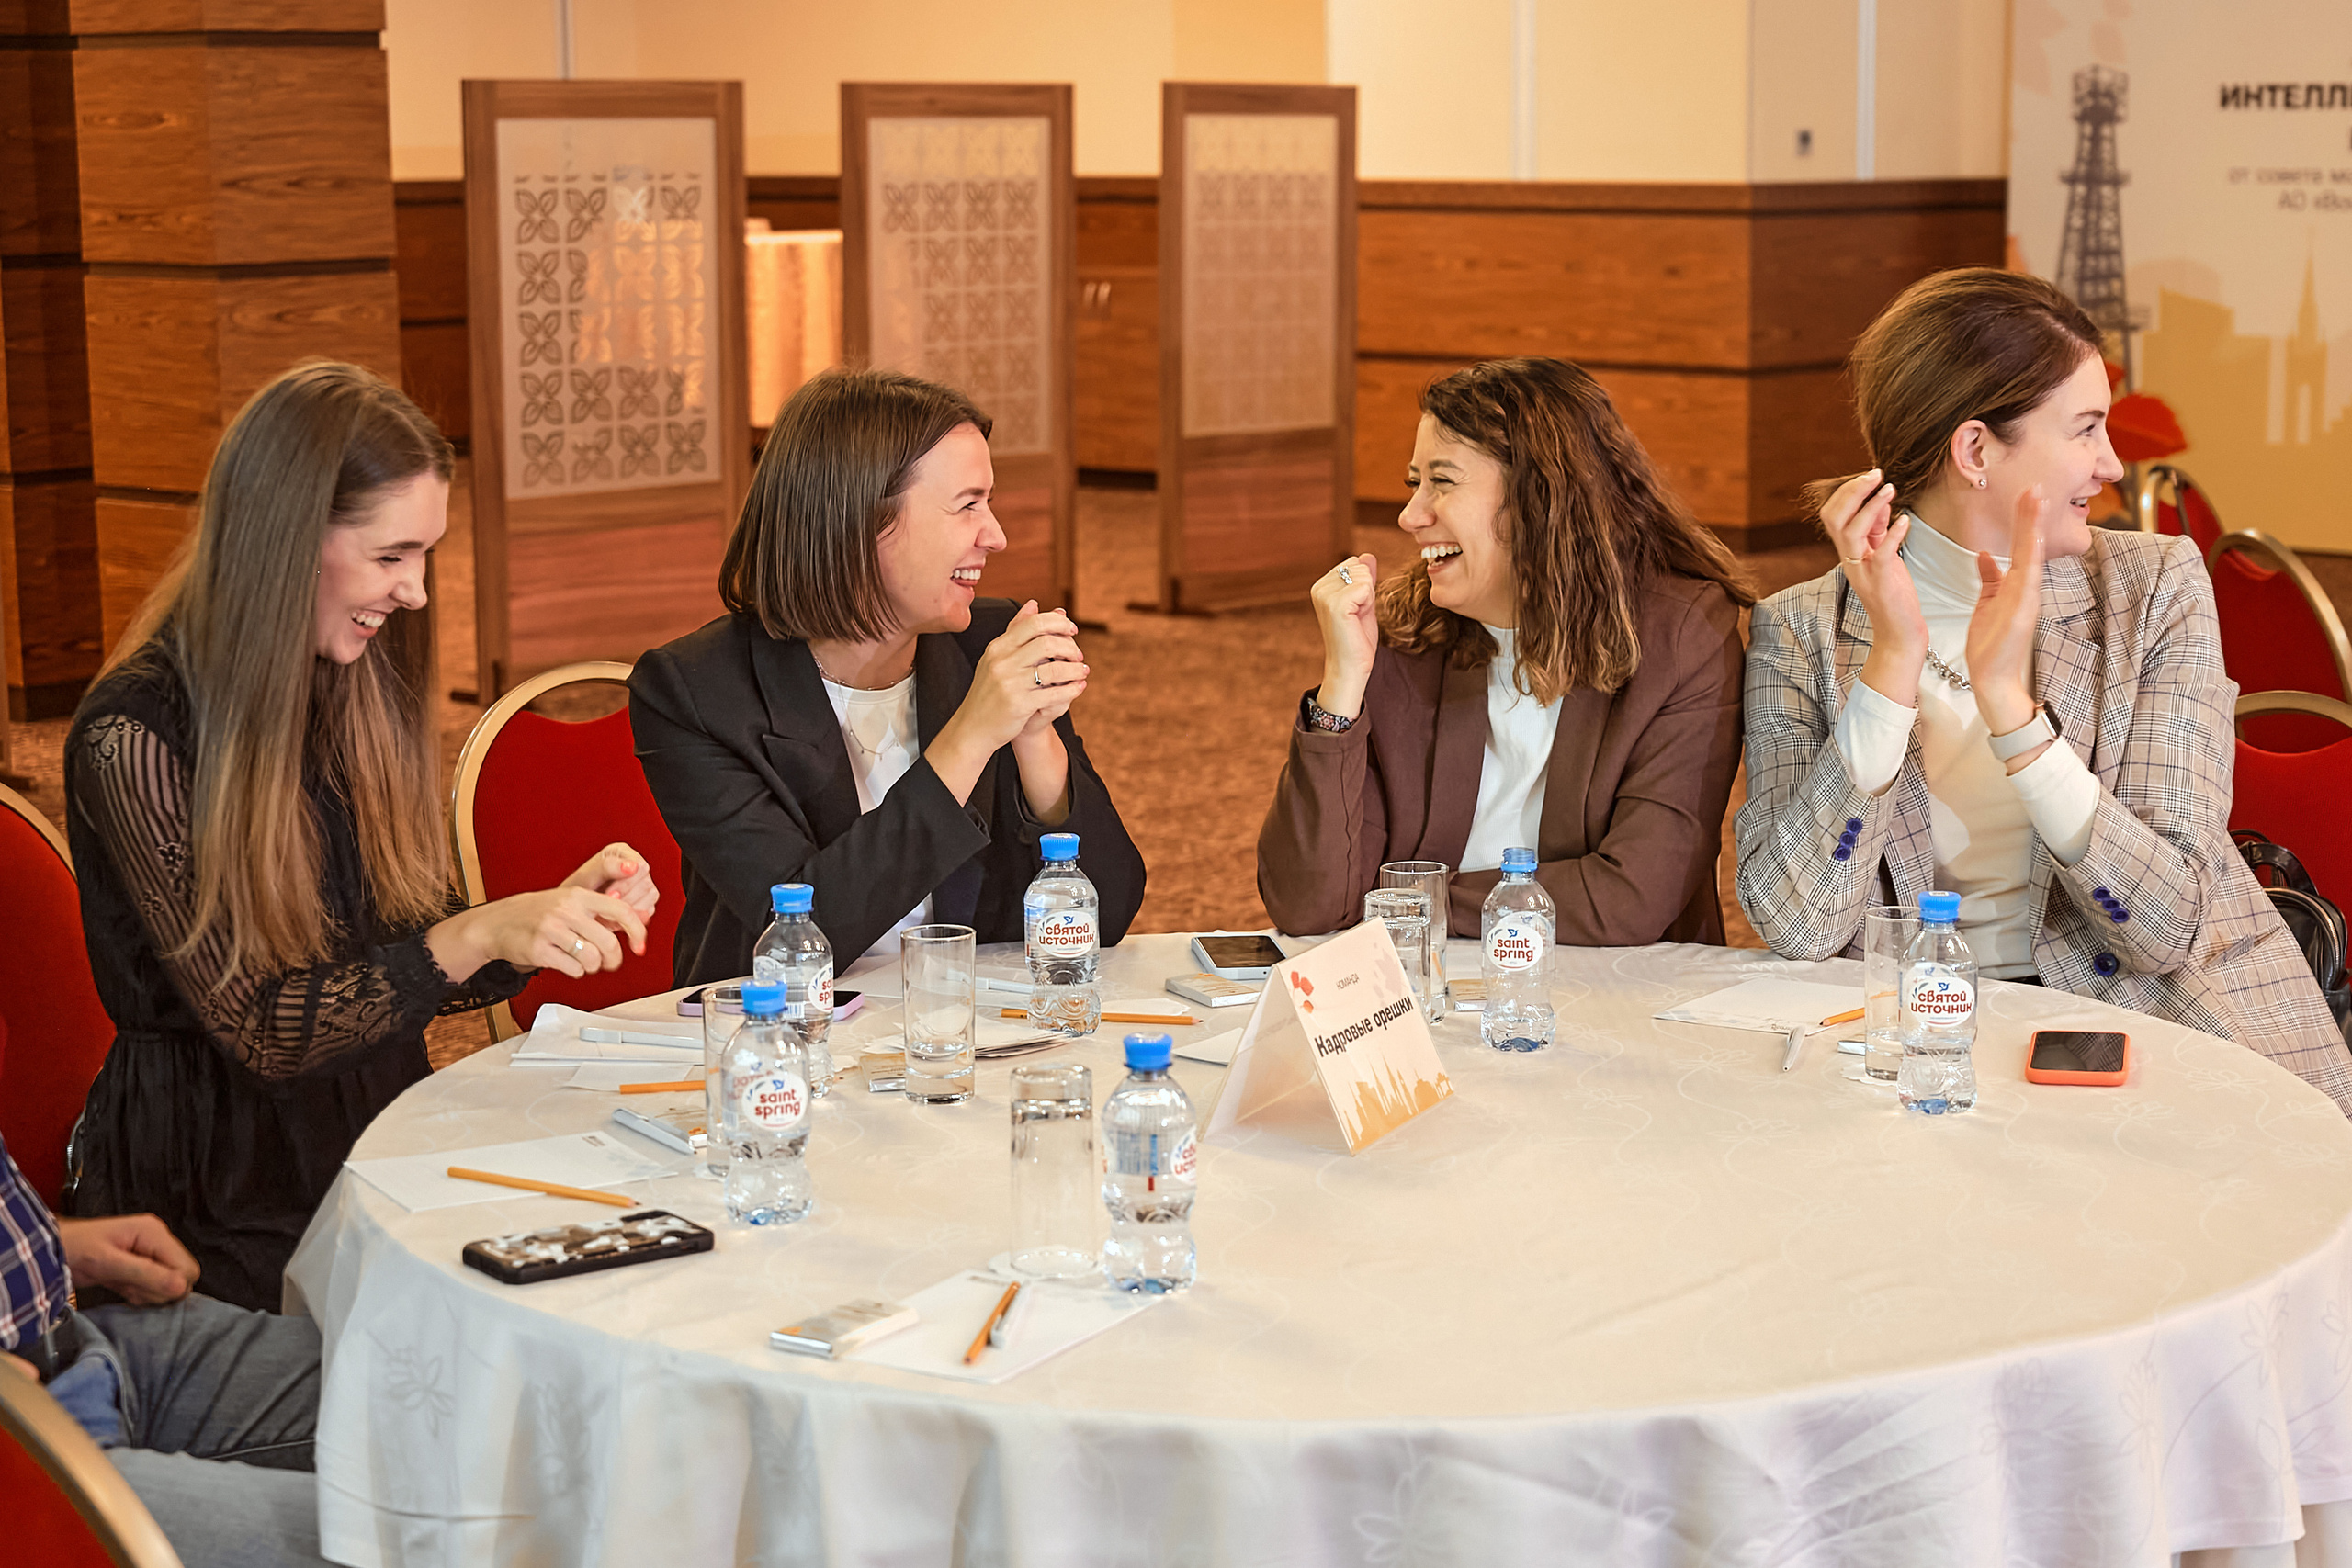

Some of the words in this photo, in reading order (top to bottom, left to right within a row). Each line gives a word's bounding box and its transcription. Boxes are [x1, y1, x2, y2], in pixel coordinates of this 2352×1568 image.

[2219, 81, 2352, 111] ИНТЕЛЛ
[1497, 938, 1530, 948] saint
[1494, 948, 1533, 962] spring
[1314, 1018, 1373, 1057] Кадровые
[1373, 996, 1414, 1030] орешки
[760, 1089, 797, 1103] saint
[755, 1101, 801, 1120] spring
